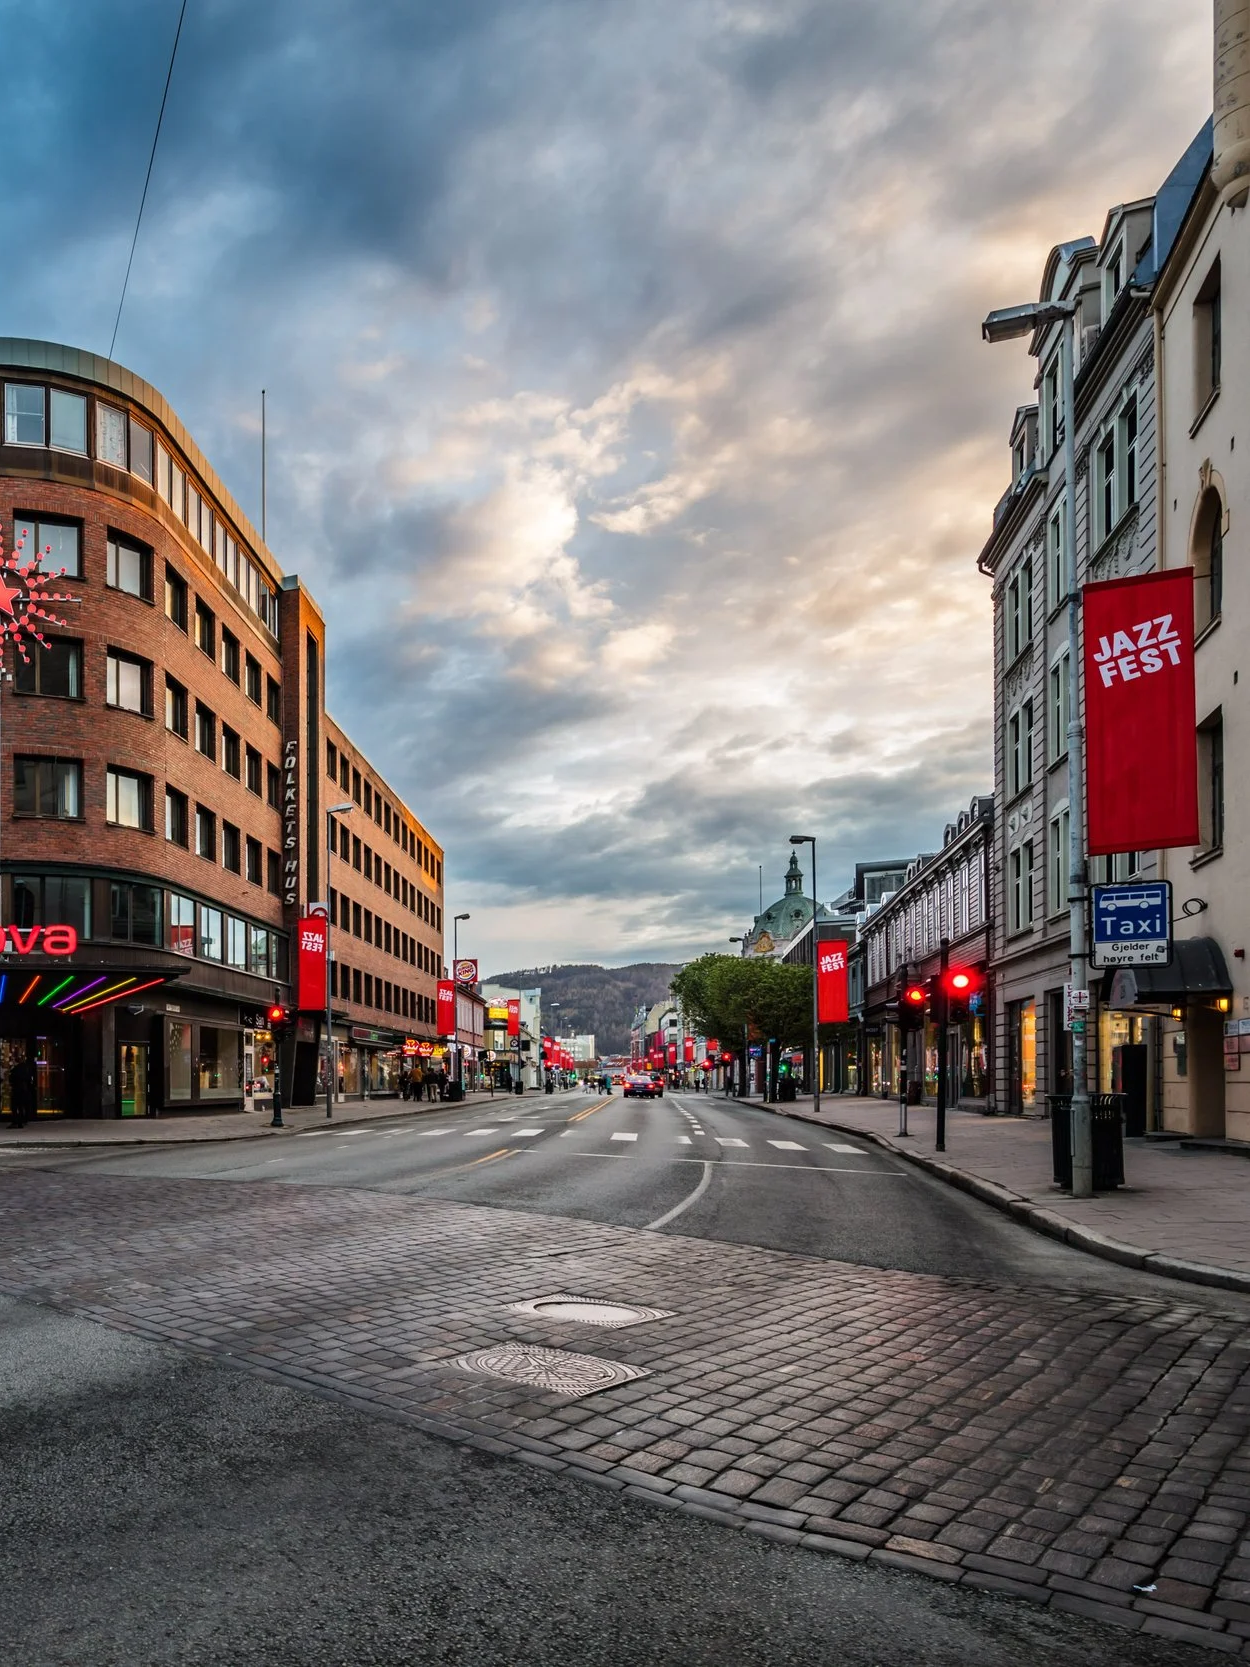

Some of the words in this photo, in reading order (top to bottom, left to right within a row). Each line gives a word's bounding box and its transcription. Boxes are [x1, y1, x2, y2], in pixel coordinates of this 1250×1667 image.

[1093, 613, 1179, 662] JAZZ
[1098, 639, 1182, 688] FEST
[284, 741, 297, 849] FOLKETS
[284, 860, 297, 905] HUS
[1100, 914, 1161, 935] Taxi
[1111, 942, 1150, 953] Gjelder
[820, 952, 843, 965] JAZZ
[821, 960, 844, 973] FEST
[1103, 955, 1134, 964] høyre
[1140, 953, 1159, 961] felt
[458, 968, 474, 977] KING
